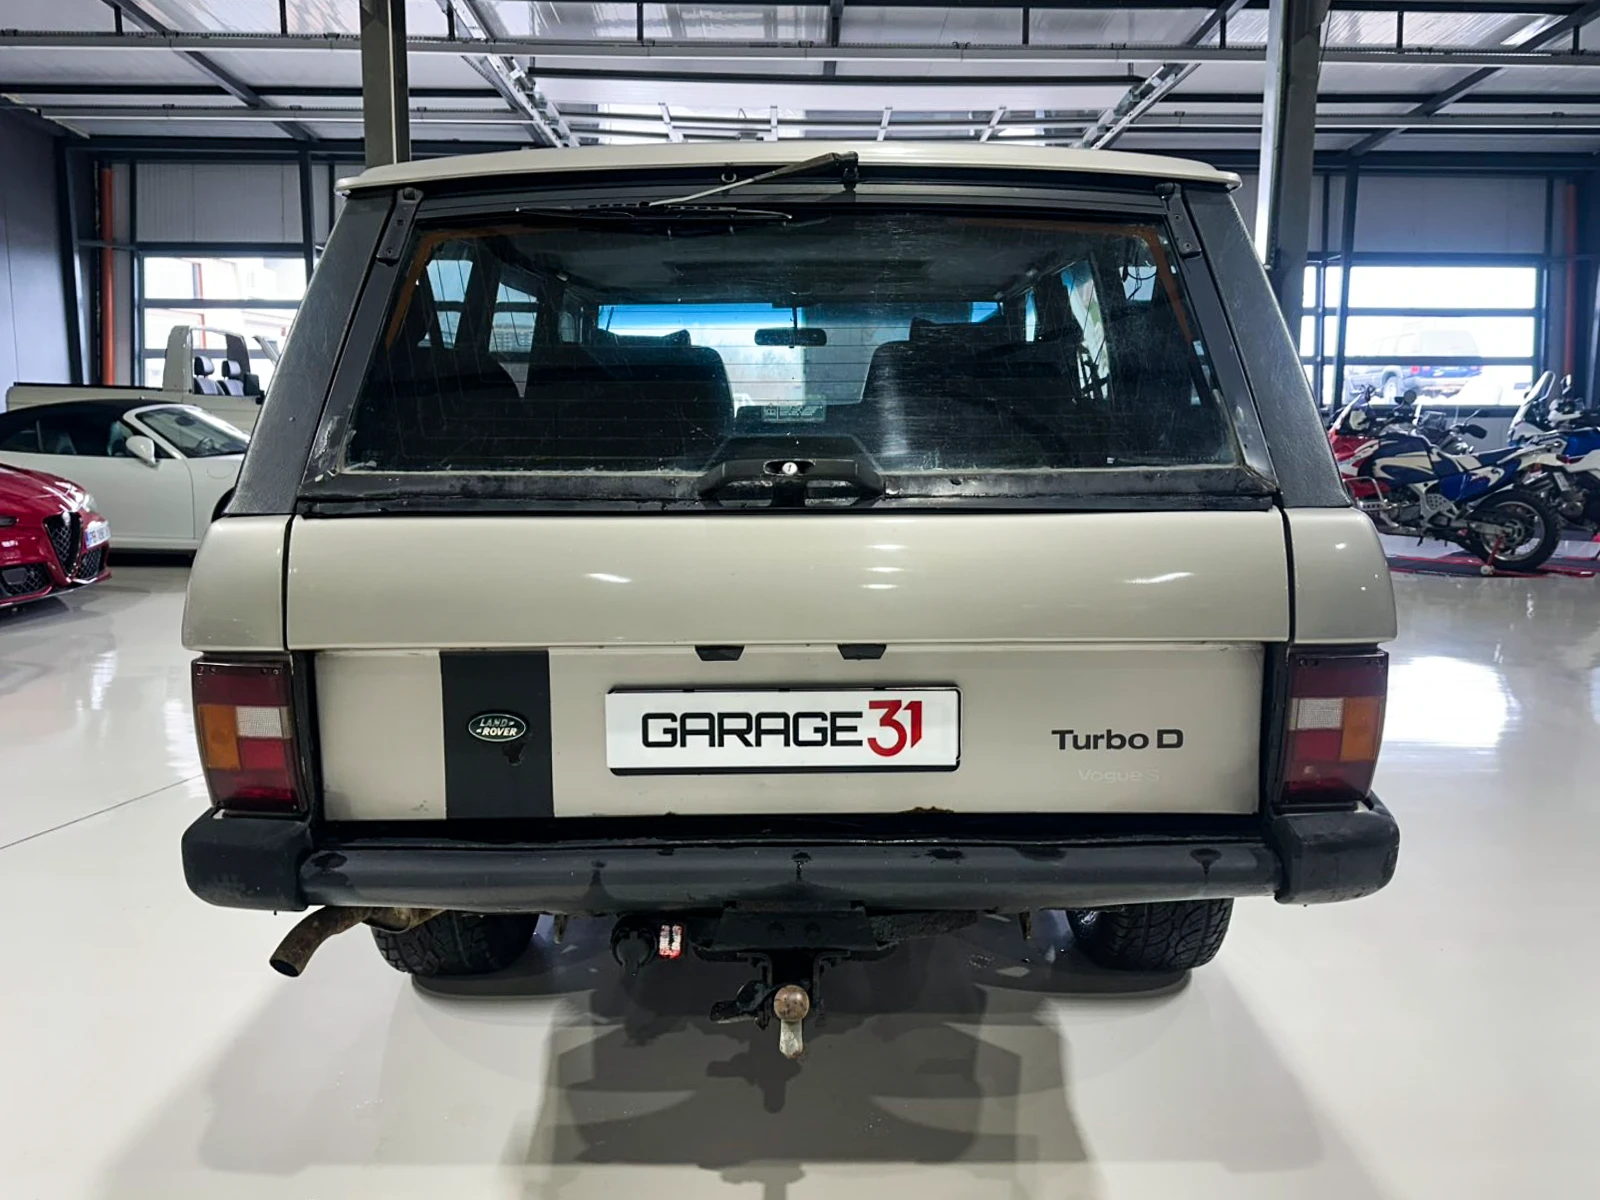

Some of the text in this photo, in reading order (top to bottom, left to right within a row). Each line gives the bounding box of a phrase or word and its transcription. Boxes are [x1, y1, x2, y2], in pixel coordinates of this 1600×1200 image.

[479, 718, 508, 727] LAND
[481, 727, 518, 736] ROVER
[1051, 729, 1184, 750] Turbo D
[1077, 768, 1142, 783] Vogue
